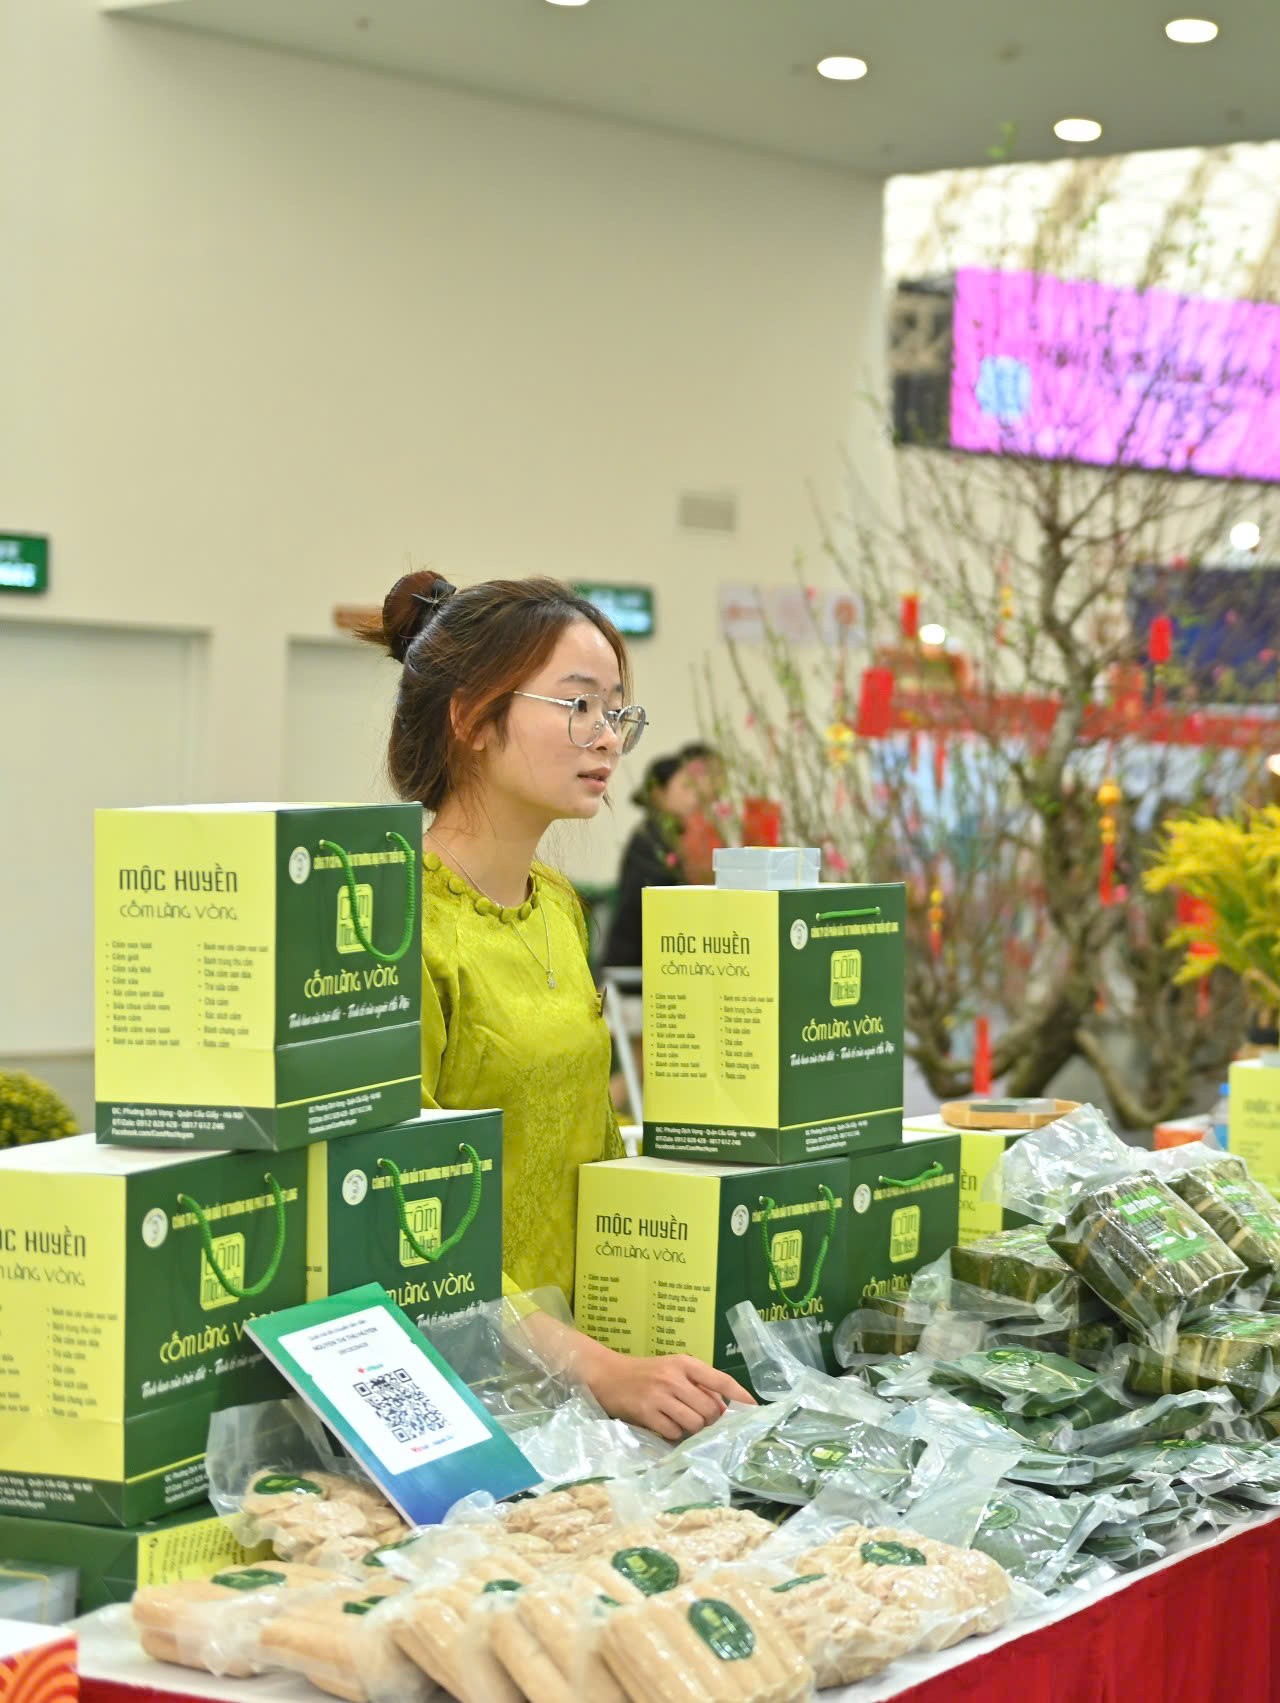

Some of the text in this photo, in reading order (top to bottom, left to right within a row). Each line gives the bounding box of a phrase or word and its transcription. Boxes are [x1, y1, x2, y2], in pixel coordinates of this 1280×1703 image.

[119, 863, 238, 894] MỘC HUYỀN
[661, 930, 750, 956] MỘC HUYỀN
[304, 964, 399, 998] CỐM LÀNG VÒNG
[802, 1014, 884, 1042] CỐM LÀNG VÒNG
[25, 1225, 86, 1257] HUYỀN
[596, 1213, 688, 1240] MỘC HUYỀN
[596, 1241, 686, 1263] CỐM LÀNG VÒNG
[399, 1272, 475, 1307] LÀNG VÒNG
[160, 1330, 196, 1364] CỐM
[198, 1324, 230, 1353] LÀNG
